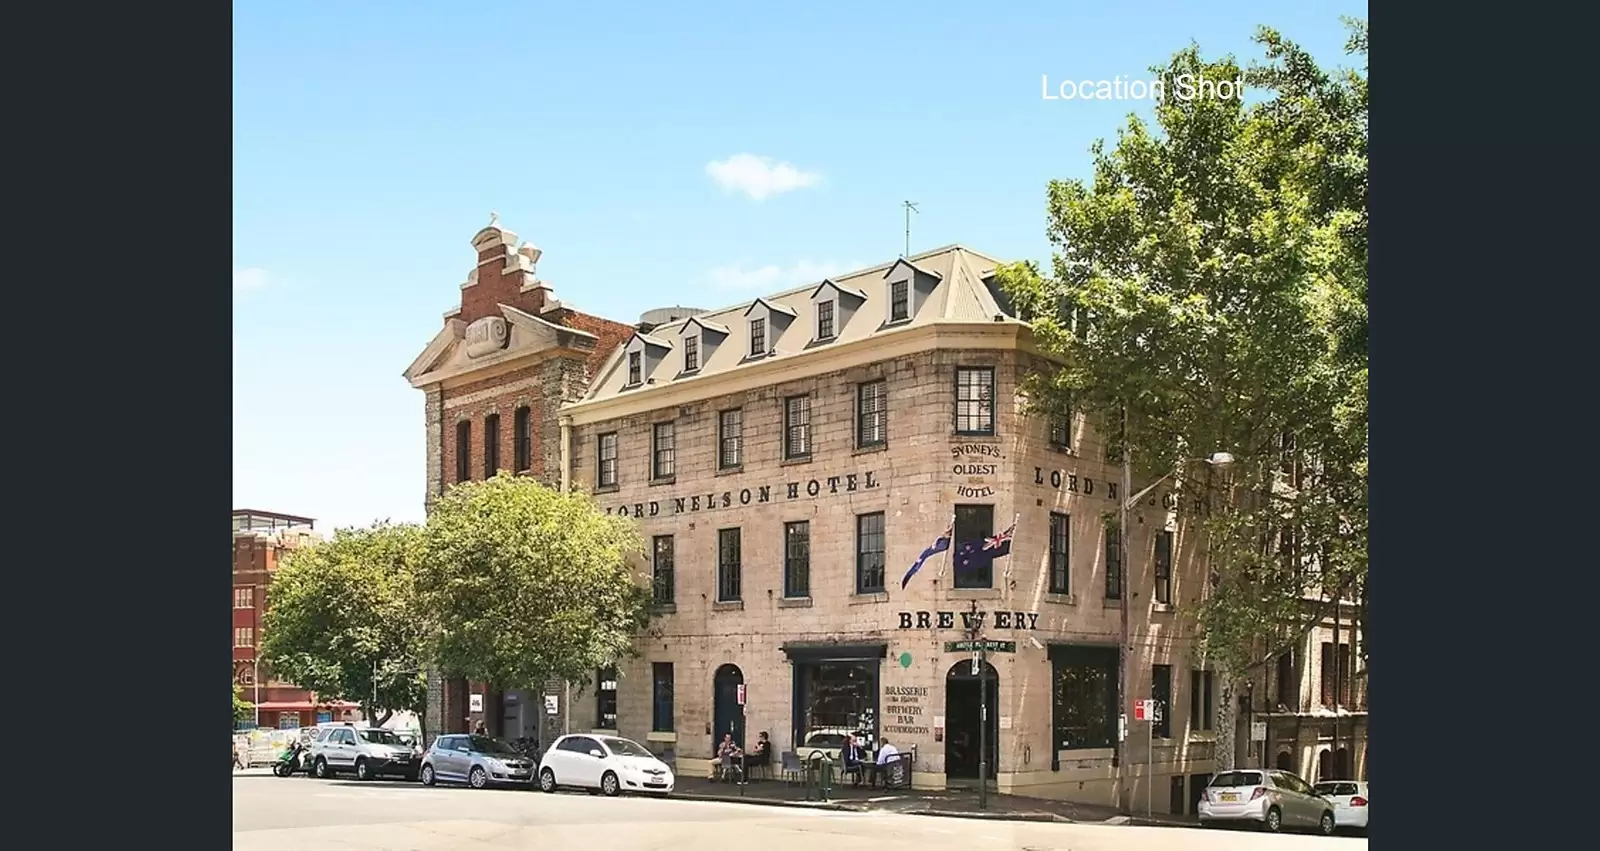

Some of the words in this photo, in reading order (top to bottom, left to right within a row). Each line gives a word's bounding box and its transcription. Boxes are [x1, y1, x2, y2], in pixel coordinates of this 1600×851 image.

[953, 464, 997, 475] OLDEST
[1034, 466, 1094, 495] LORD
[957, 485, 995, 498] HOTEL
[675, 485, 771, 513] NELSON
[898, 611, 1039, 630] BREWERY
[885, 686, 929, 696] BRASSERIE
[887, 705, 922, 715] BREWERY
[897, 715, 914, 724] BAR
